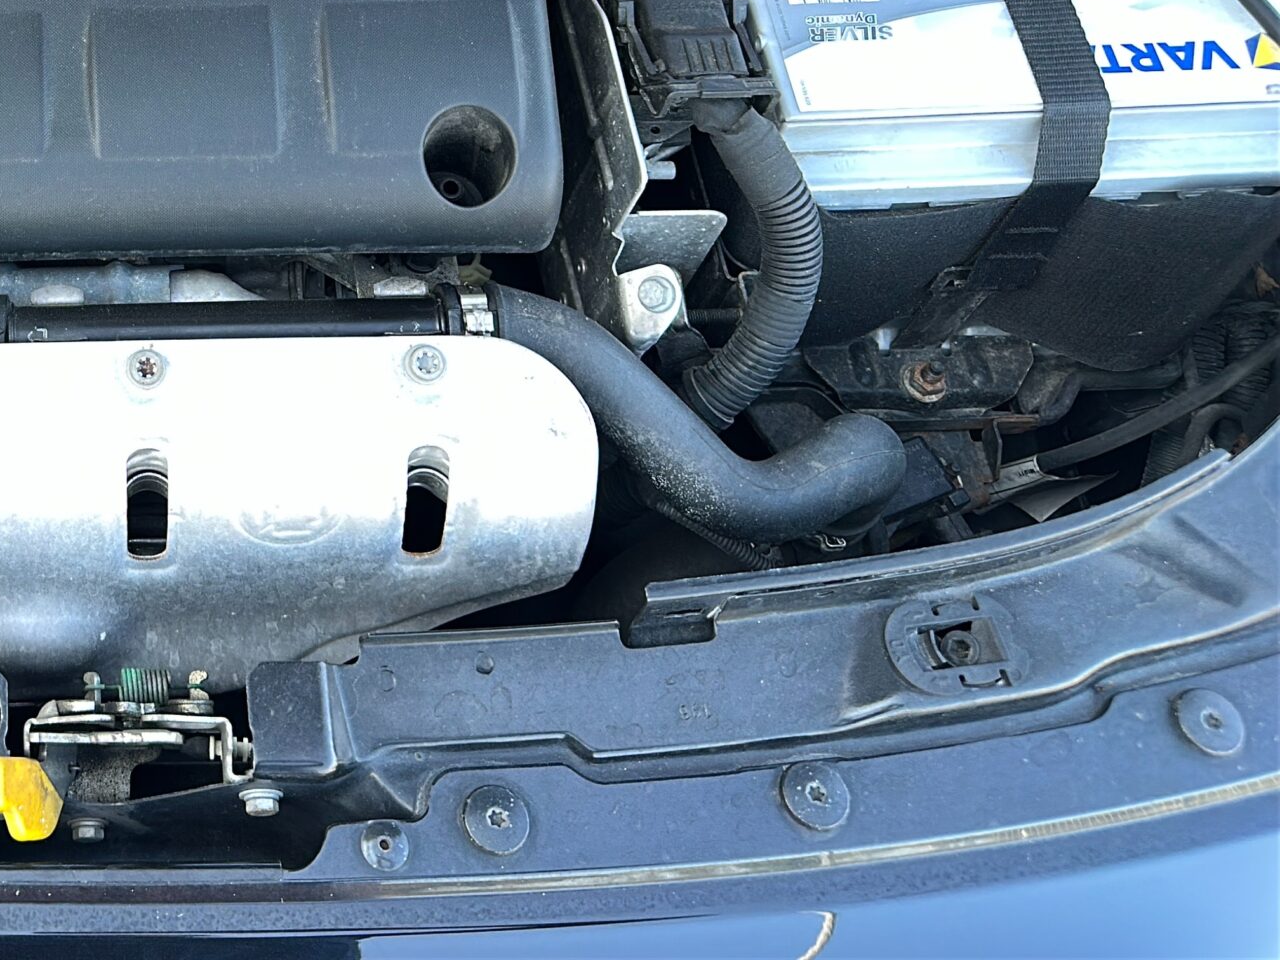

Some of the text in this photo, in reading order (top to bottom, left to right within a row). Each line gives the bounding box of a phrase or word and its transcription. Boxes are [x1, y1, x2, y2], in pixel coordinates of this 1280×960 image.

[805, 11, 877, 26] Dynamic
[808, 24, 894, 43] SILVER
[1088, 40, 1241, 74] VART
